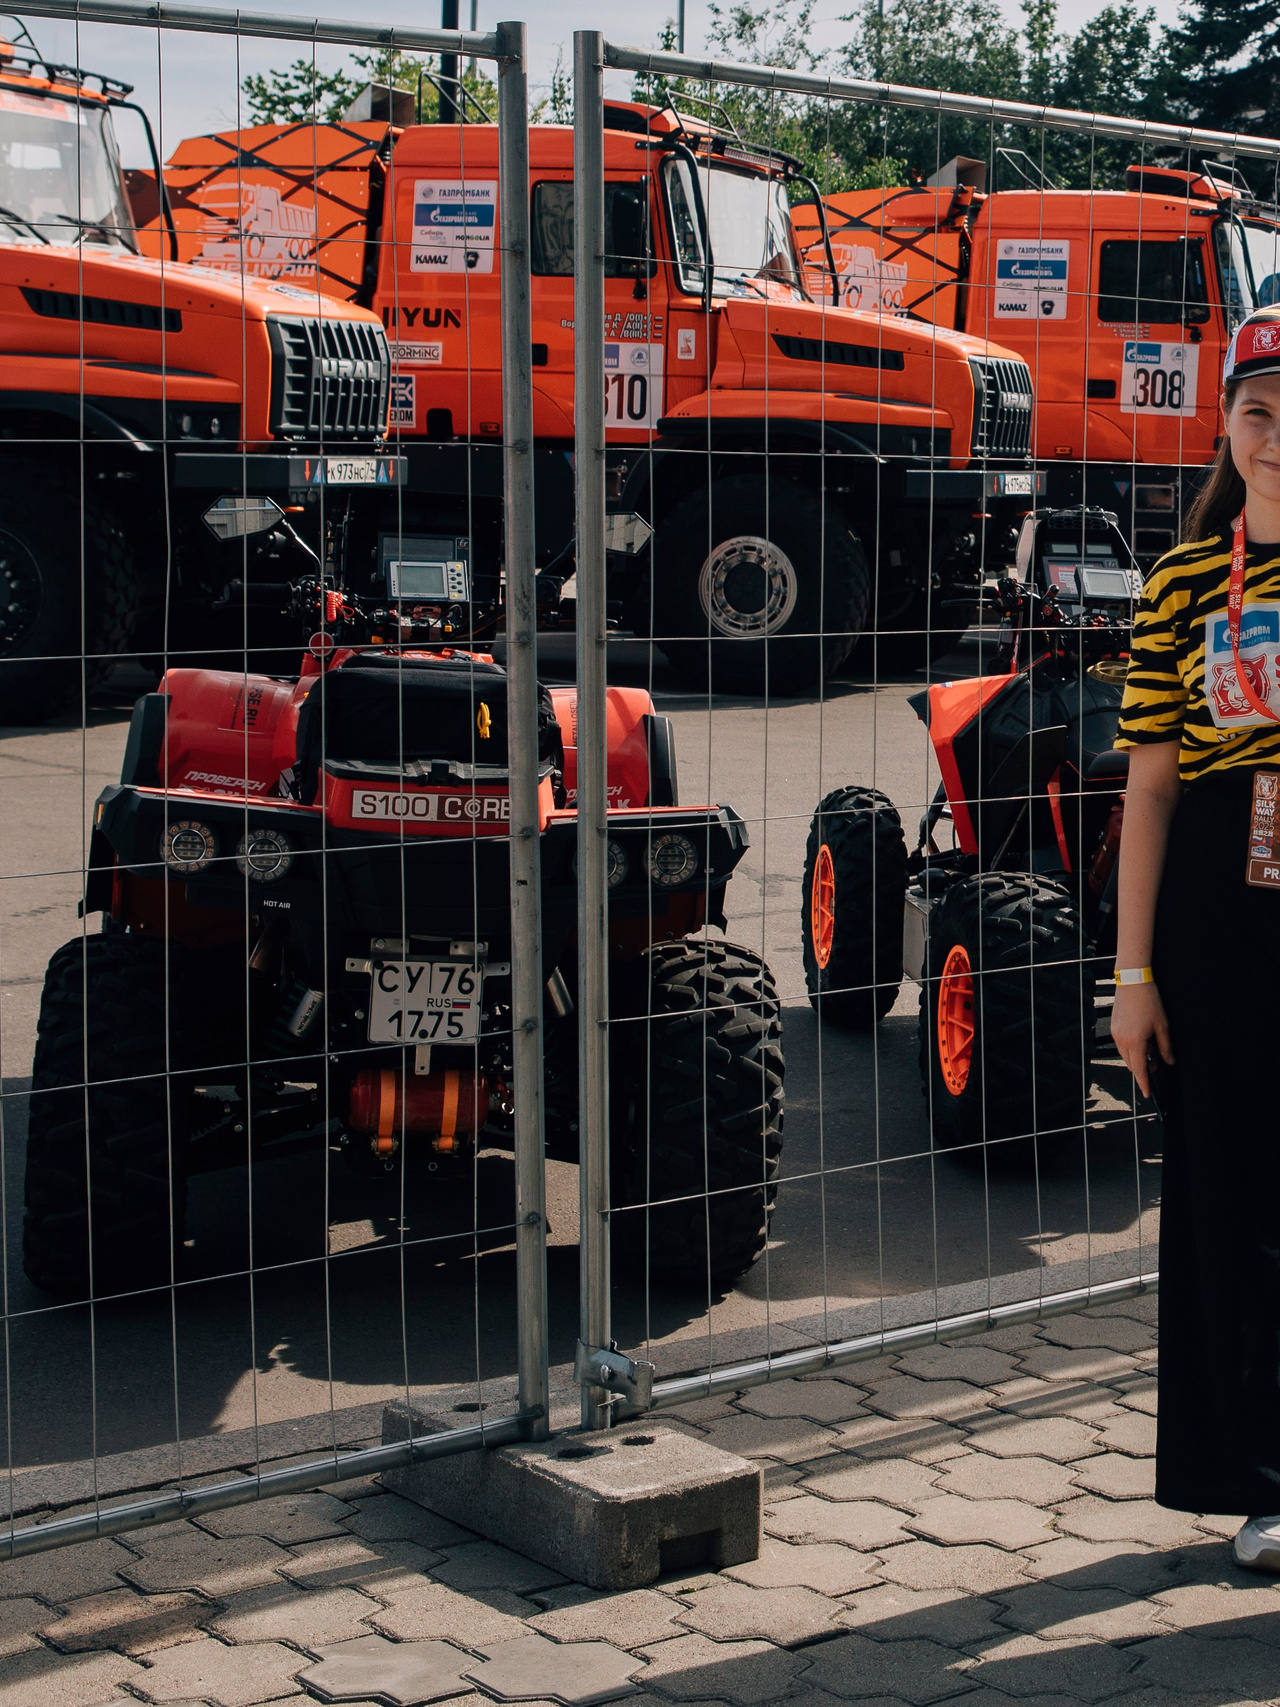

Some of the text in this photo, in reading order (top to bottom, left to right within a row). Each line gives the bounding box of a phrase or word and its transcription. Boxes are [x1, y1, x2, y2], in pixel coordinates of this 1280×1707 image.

[438, 189, 490, 198] ГАЗПРОМБАНК
[1017, 247, 1064, 255] ГАЗПРОМБАНК
[415, 254, 449, 265] KAMAZ
[998, 303, 1028, 312] KAMAZ
[322, 359, 378, 379] URAL
[1132, 368, 1186, 409] 308
[604, 374, 648, 421] 10
[1234, 593, 1242, 610] SILK
[184, 770, 267, 792] ПРОВЕРЕН
[360, 794, 431, 818] S100
[1255, 800, 1276, 809] SILK
[1256, 807, 1276, 817] WAY
[1254, 815, 1275, 823] RALLY
[1253, 821, 1275, 831] 2025
[263, 899, 291, 909] HOT AIR
[439, 966, 475, 995] 76
[426, 997, 452, 1008] RUS
[387, 1009, 464, 1038] 1775
